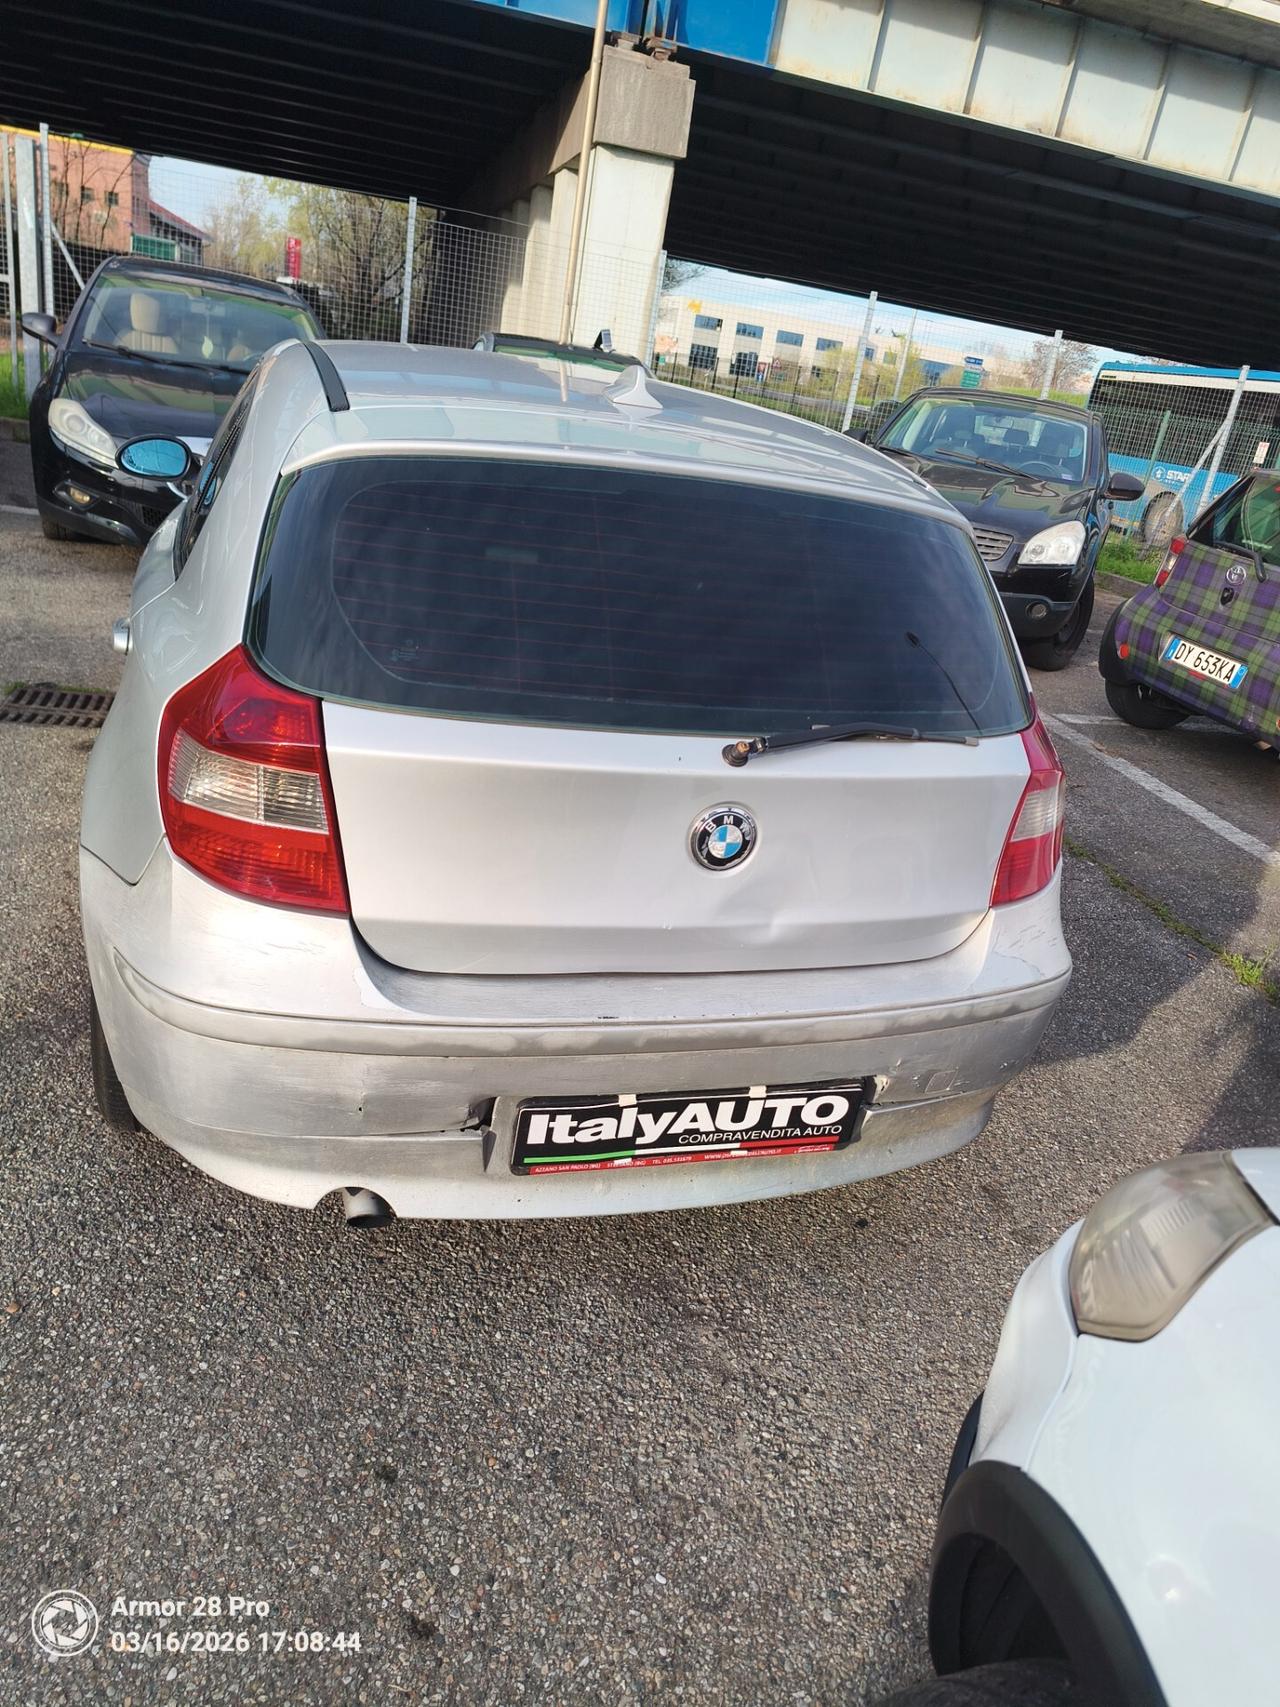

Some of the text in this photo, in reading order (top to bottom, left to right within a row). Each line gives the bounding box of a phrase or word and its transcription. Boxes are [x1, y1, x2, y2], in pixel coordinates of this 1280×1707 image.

[1166, 470, 1191, 482] STAR
[1174, 643, 1195, 663] DY
[1193, 651, 1236, 682] 653KA
[526, 1095, 849, 1145] ItalyAUTO
[678, 1125, 843, 1144] COMPRAVENDITA AUTO
